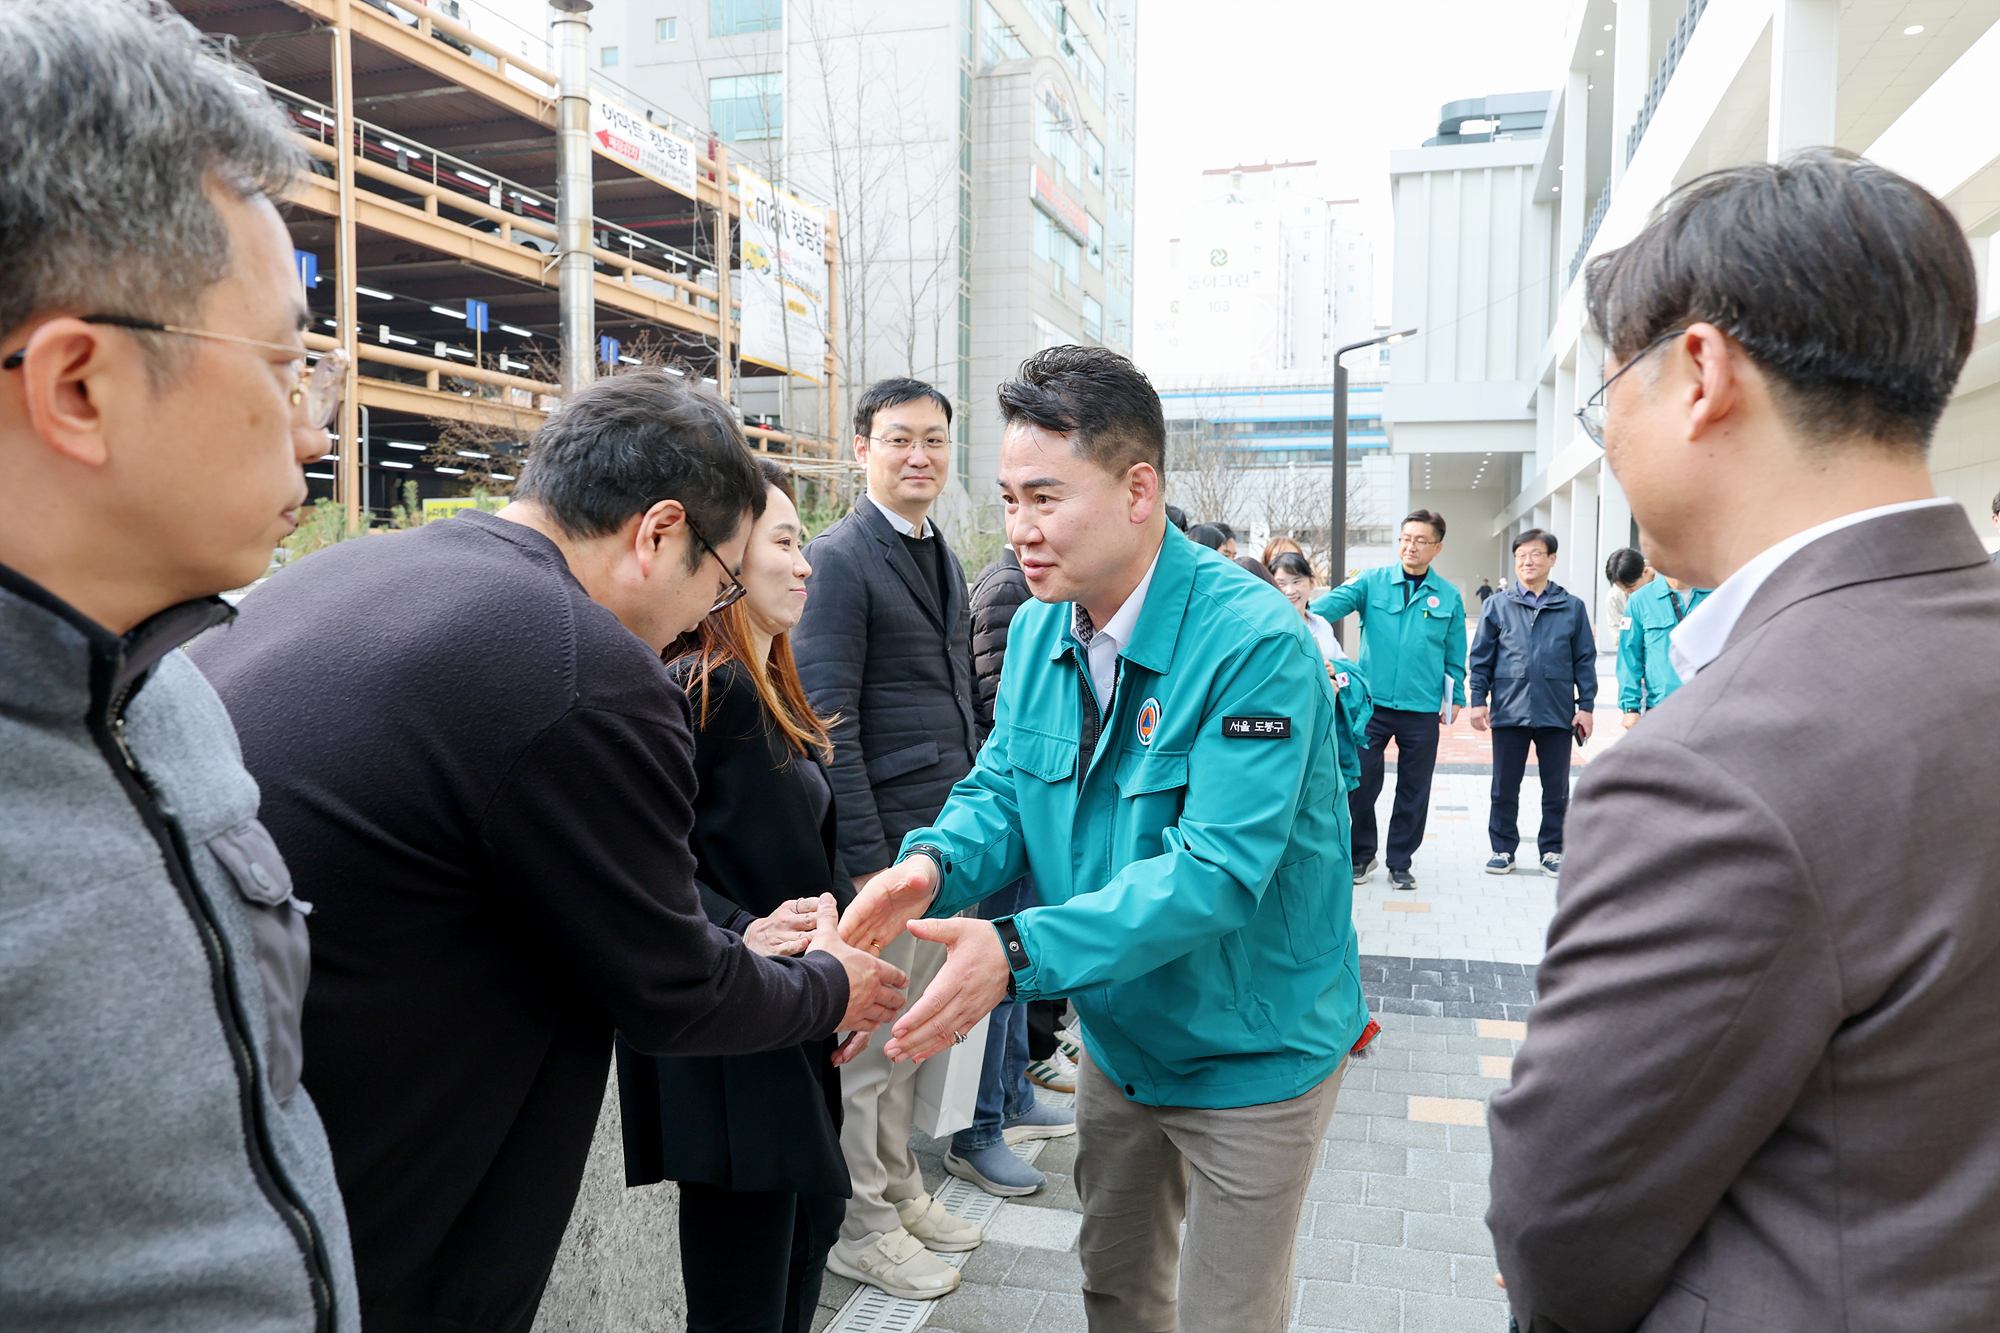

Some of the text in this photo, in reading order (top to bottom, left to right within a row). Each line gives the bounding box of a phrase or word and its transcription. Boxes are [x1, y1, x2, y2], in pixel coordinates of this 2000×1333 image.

[602, 103, 688, 166] 이마트 창동점
[1187, 273, 1250, 291] 동아그린
[1207, 300, 1231, 313] 103
[1229, 720, 1284, 733] 서울 도봉구
